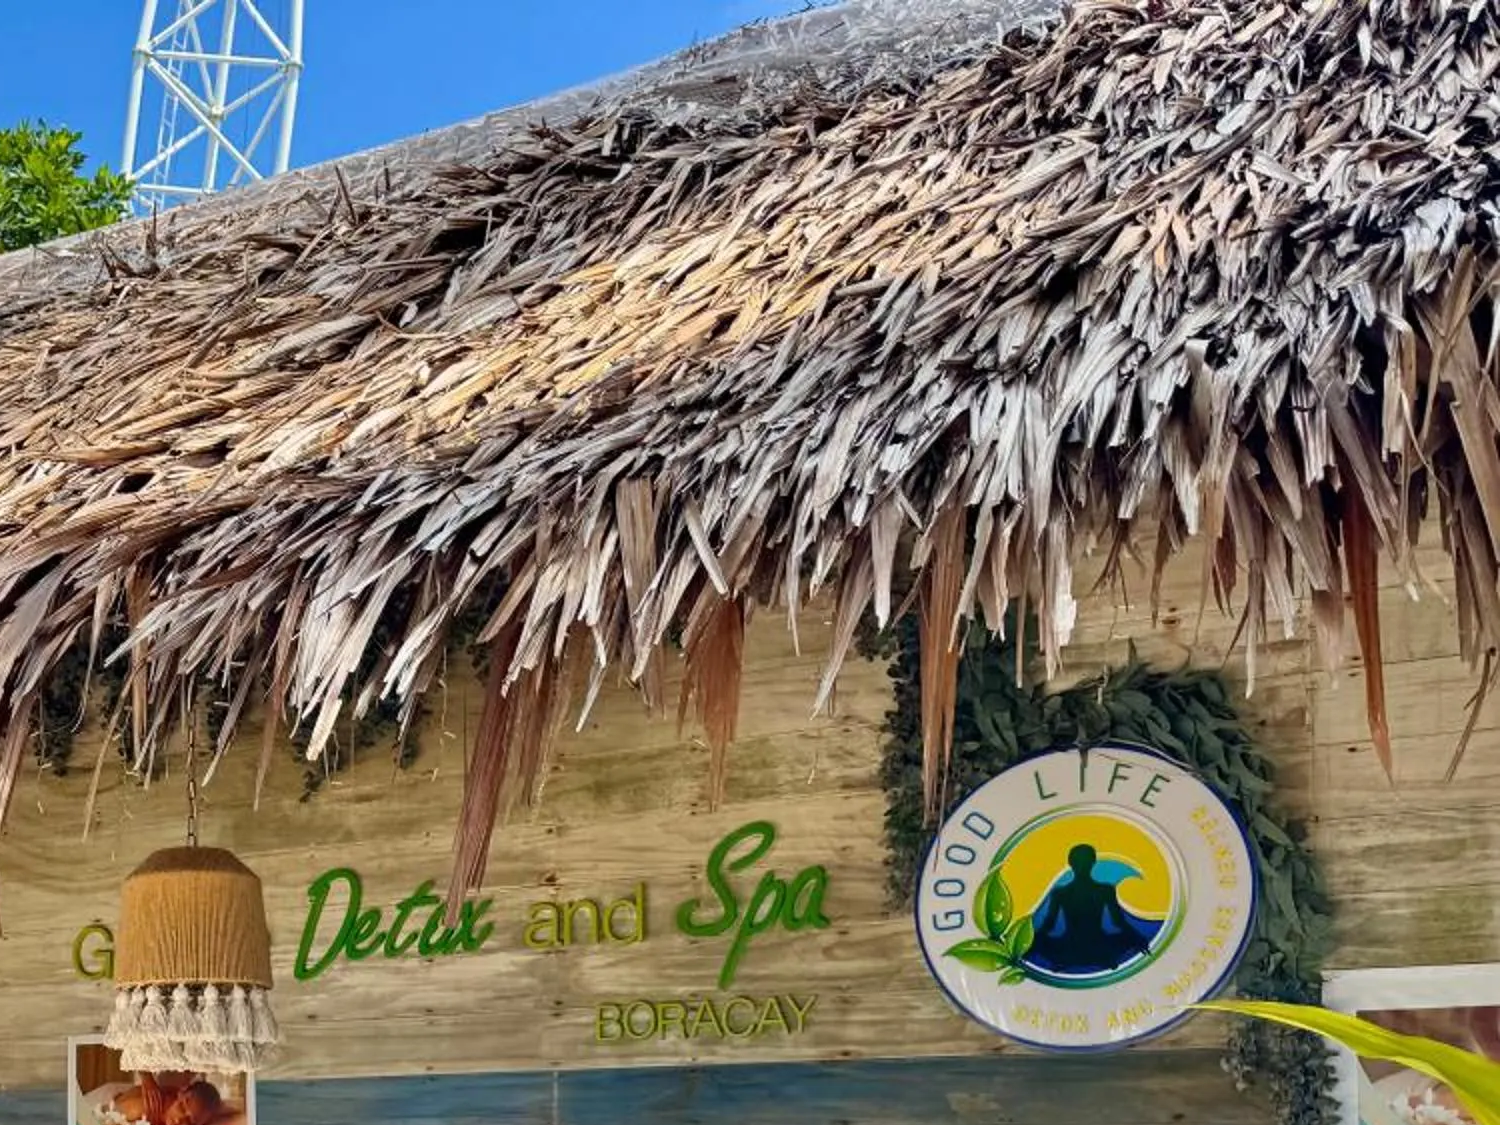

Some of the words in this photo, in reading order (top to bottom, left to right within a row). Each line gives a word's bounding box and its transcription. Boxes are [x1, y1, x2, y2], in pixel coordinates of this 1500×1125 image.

[522, 881, 646, 949] and
[675, 820, 833, 991] Spa
[932, 811, 996, 933] GOOD
[1034, 762, 1171, 808] LIFE
[594, 995, 818, 1043] BORACAY
